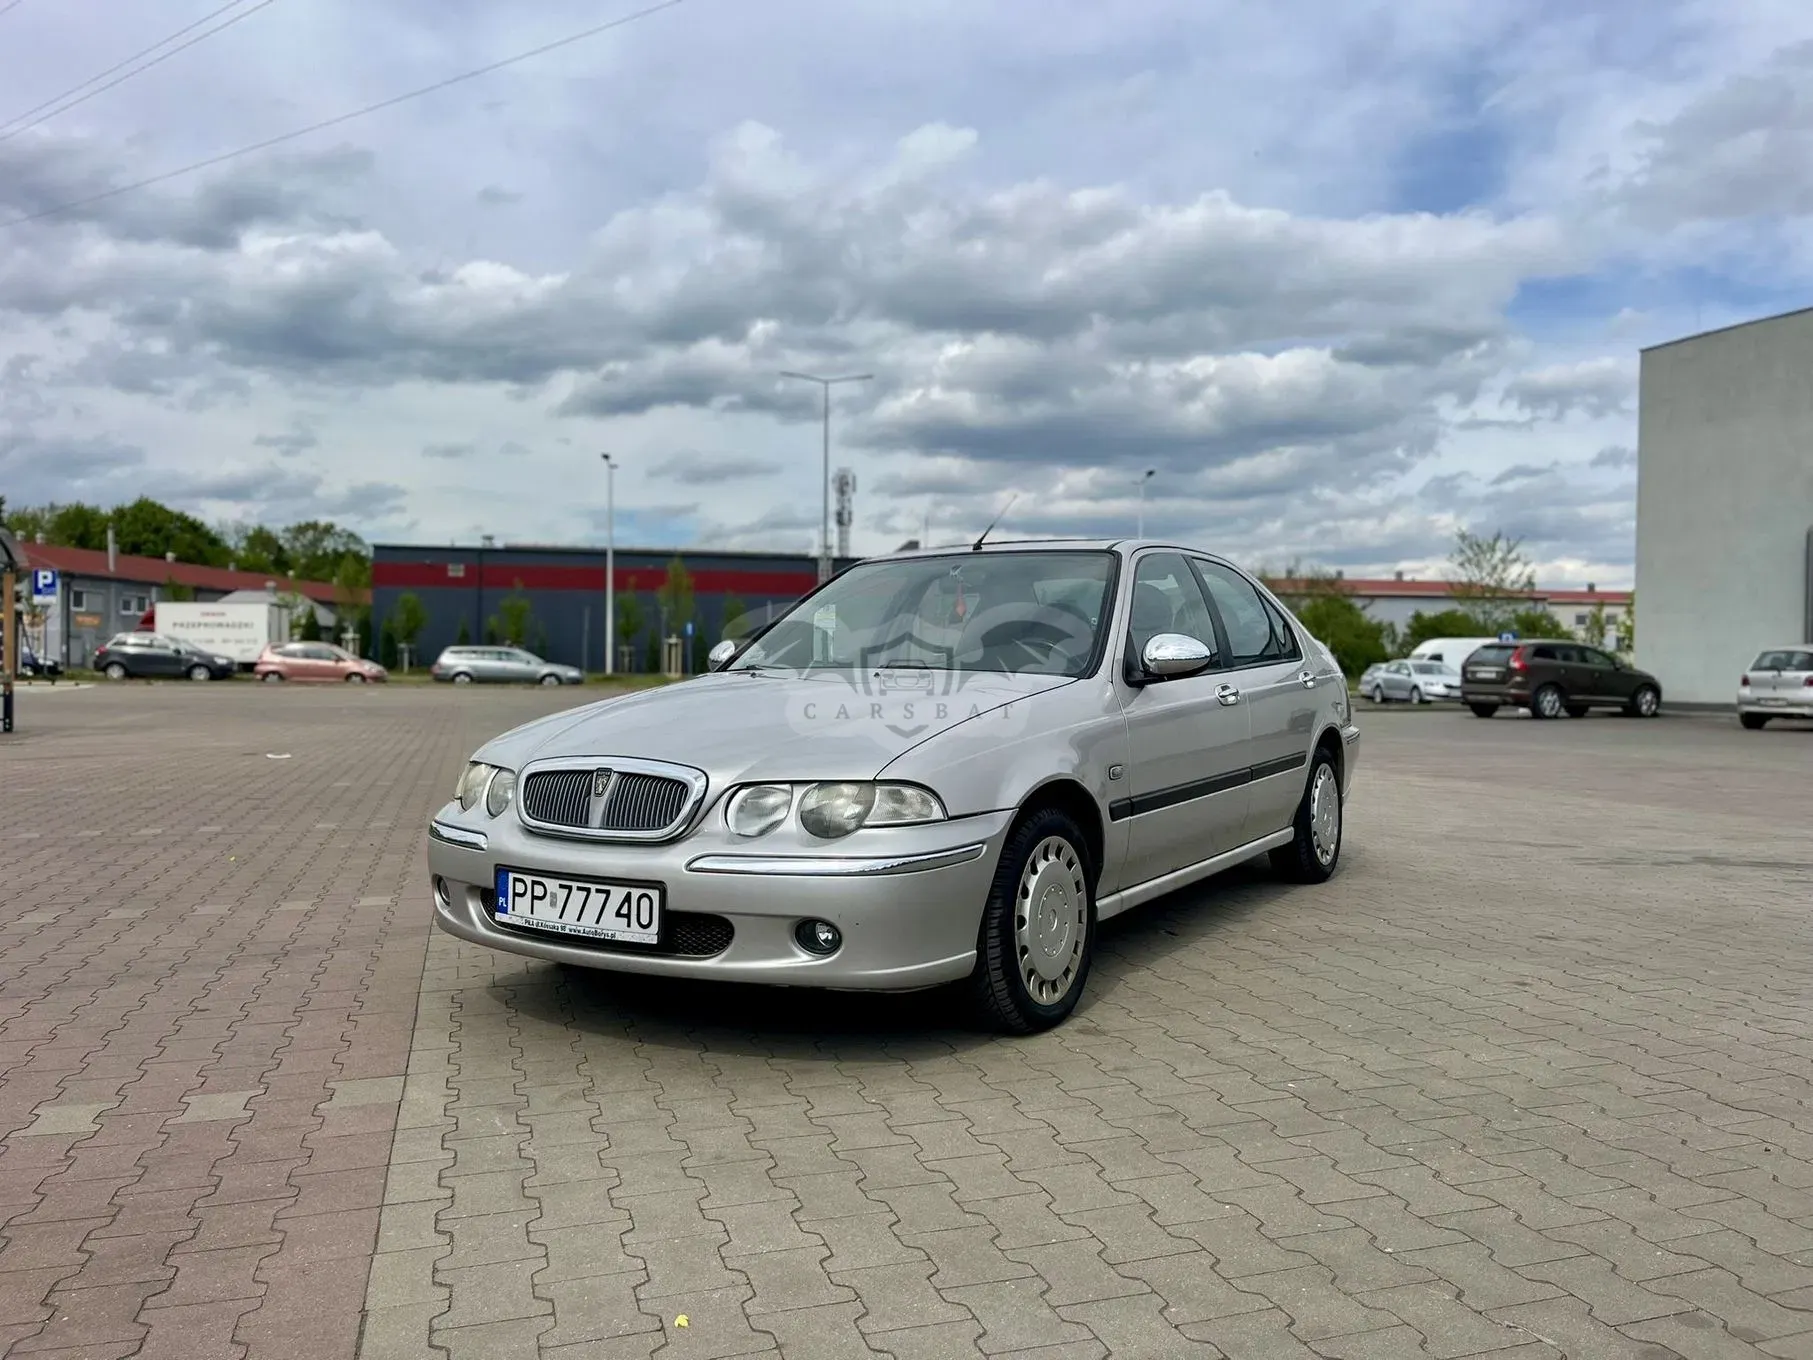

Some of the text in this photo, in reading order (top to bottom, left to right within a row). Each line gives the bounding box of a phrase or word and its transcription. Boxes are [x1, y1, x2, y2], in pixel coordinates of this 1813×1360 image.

[38, 571, 53, 588] P
[498, 898, 507, 908] PL
[511, 877, 653, 930] PP 77740
